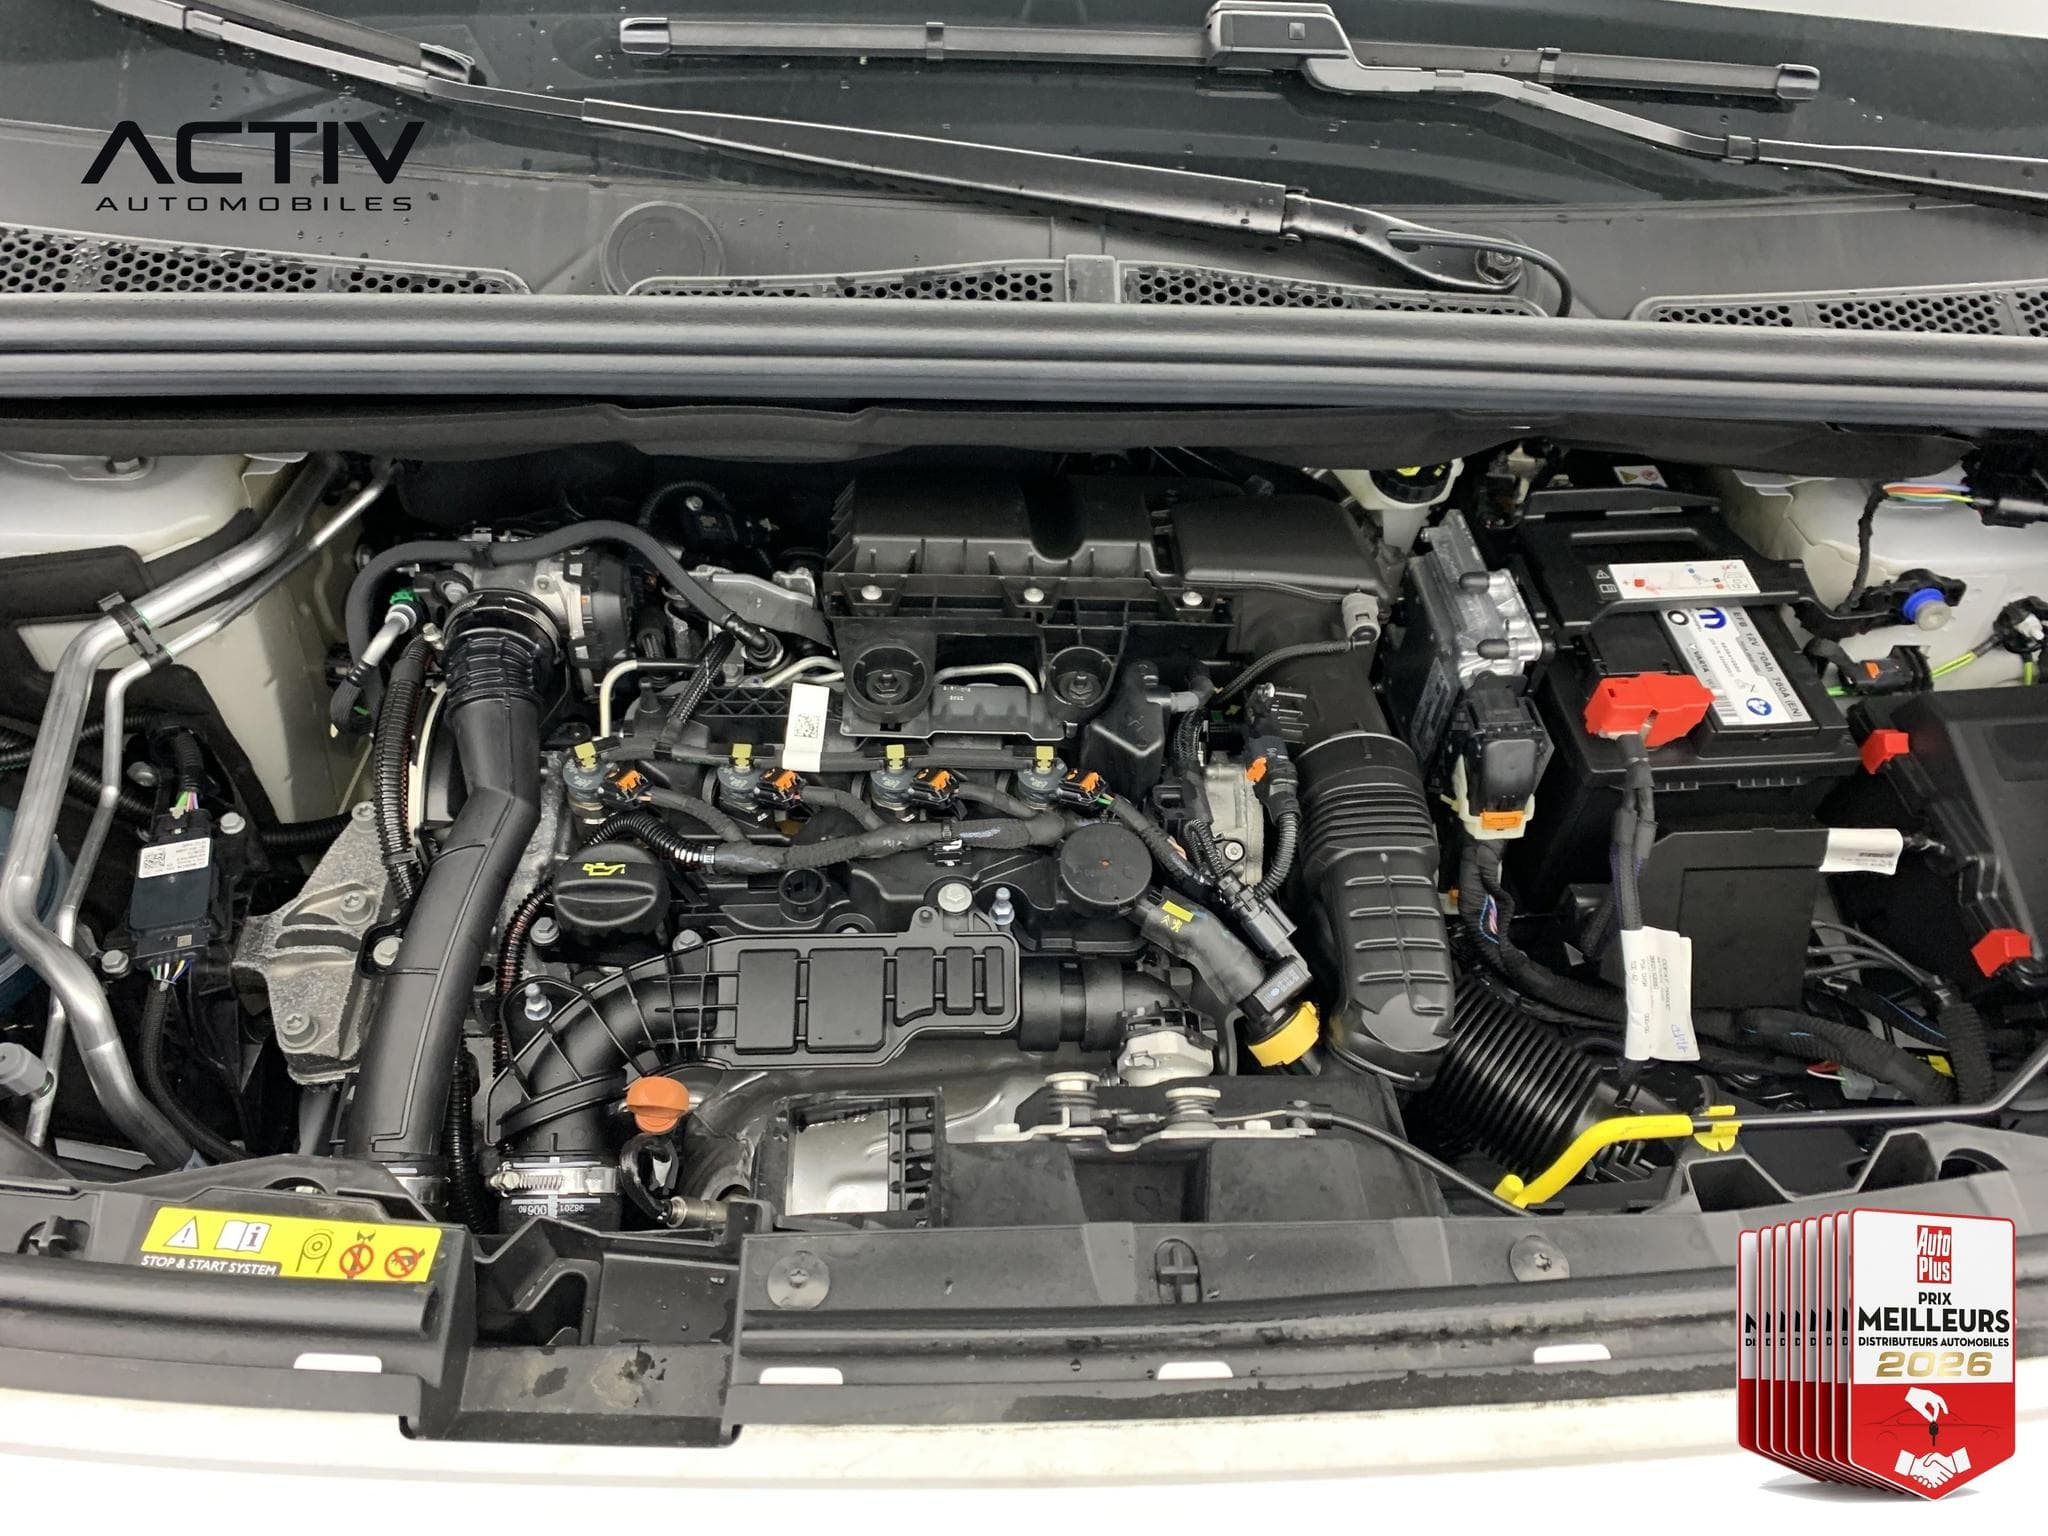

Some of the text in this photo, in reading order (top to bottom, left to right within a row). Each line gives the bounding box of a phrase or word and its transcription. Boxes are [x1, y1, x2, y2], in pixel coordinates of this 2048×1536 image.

[1732, 611, 1748, 628] EFB
[1746, 632, 1760, 647] 12V
[1758, 651, 1773, 673] 70Ah
[141, 1255, 277, 1275] STOP & START SYSTEM
